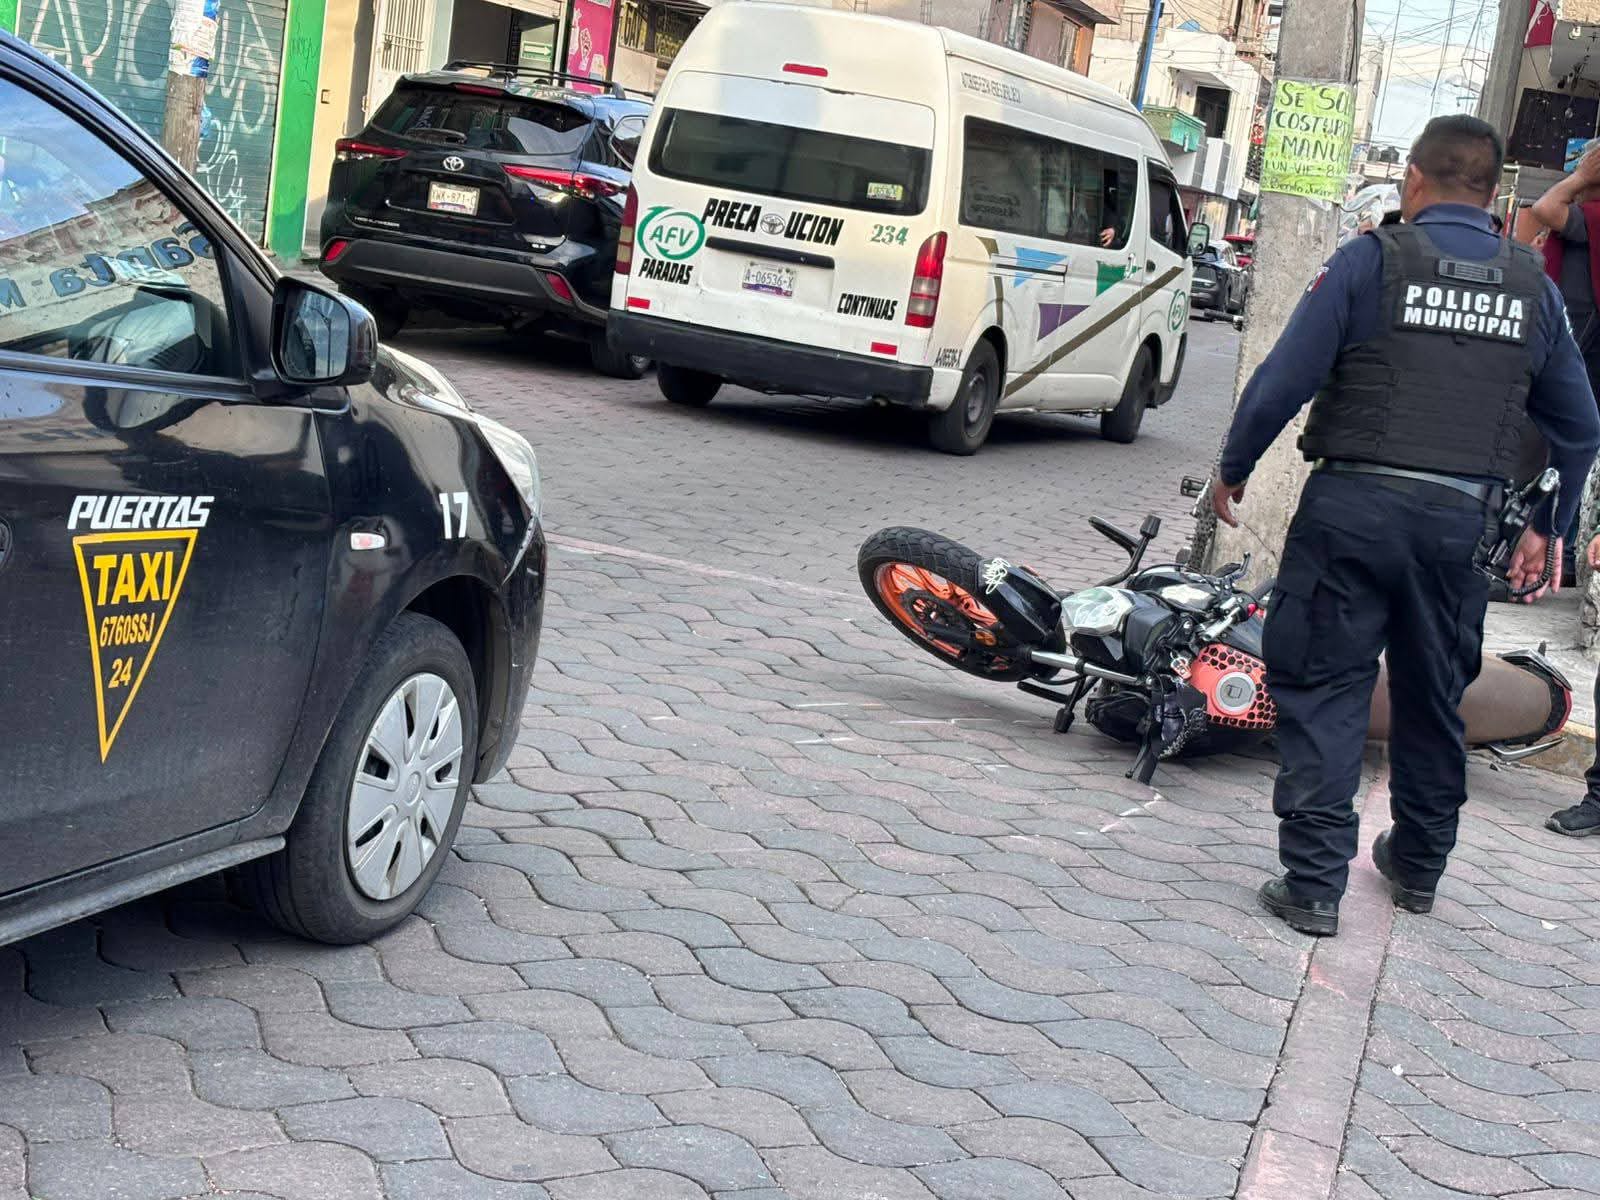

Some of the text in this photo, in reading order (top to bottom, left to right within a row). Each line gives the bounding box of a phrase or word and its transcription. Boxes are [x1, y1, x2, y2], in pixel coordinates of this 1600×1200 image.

[1280, 82, 1304, 108] SE
[650, 225, 694, 247] AFV
[701, 198, 844, 246] PRECA UCION
[870, 223, 909, 246] 234
[638, 257, 694, 285] PARADAS
[837, 293, 898, 321] CONTINUAS
[1405, 285, 1524, 320] POLICÍA
[1403, 306, 1521, 339] MUNICIPAL
[67, 496, 215, 530] PUERTAS
[439, 491, 469, 539] 17
[93, 551, 174, 606] TAXI
[100, 611, 156, 648] 6760SSJ
[108, 656, 134, 689] 24
